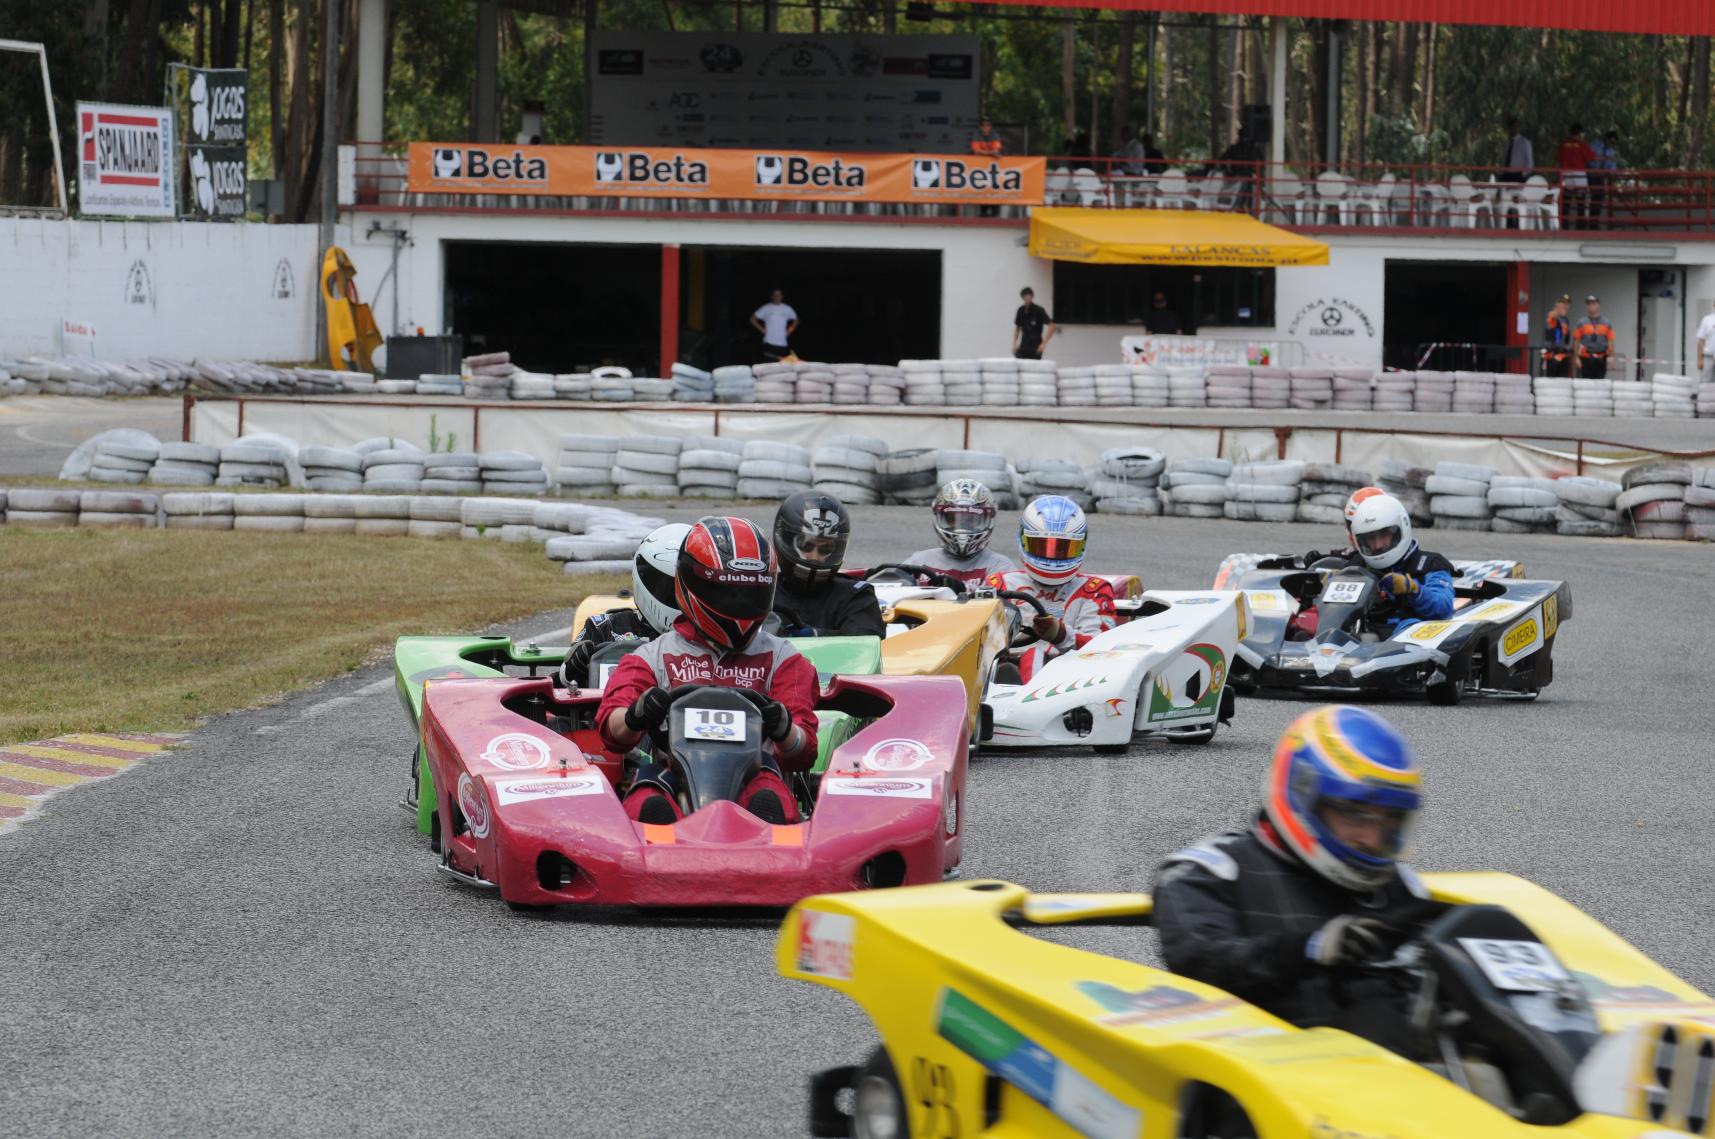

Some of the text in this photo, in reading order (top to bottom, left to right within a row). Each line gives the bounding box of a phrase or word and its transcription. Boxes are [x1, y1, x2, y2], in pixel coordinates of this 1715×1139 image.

[99, 128, 159, 173] SPANJAARD
[467, 150, 546, 179] Beta
[629, 154, 708, 183] Beta
[787, 157, 865, 187] Beta
[945, 161, 1022, 190] Beta
[719, 574, 773, 584] clube bcp
[1335, 583, 1358, 592] 88
[1505, 623, 1536, 651] CIMEIRA
[735, 676, 753, 688] bcp
[695, 711, 734, 725] 10
